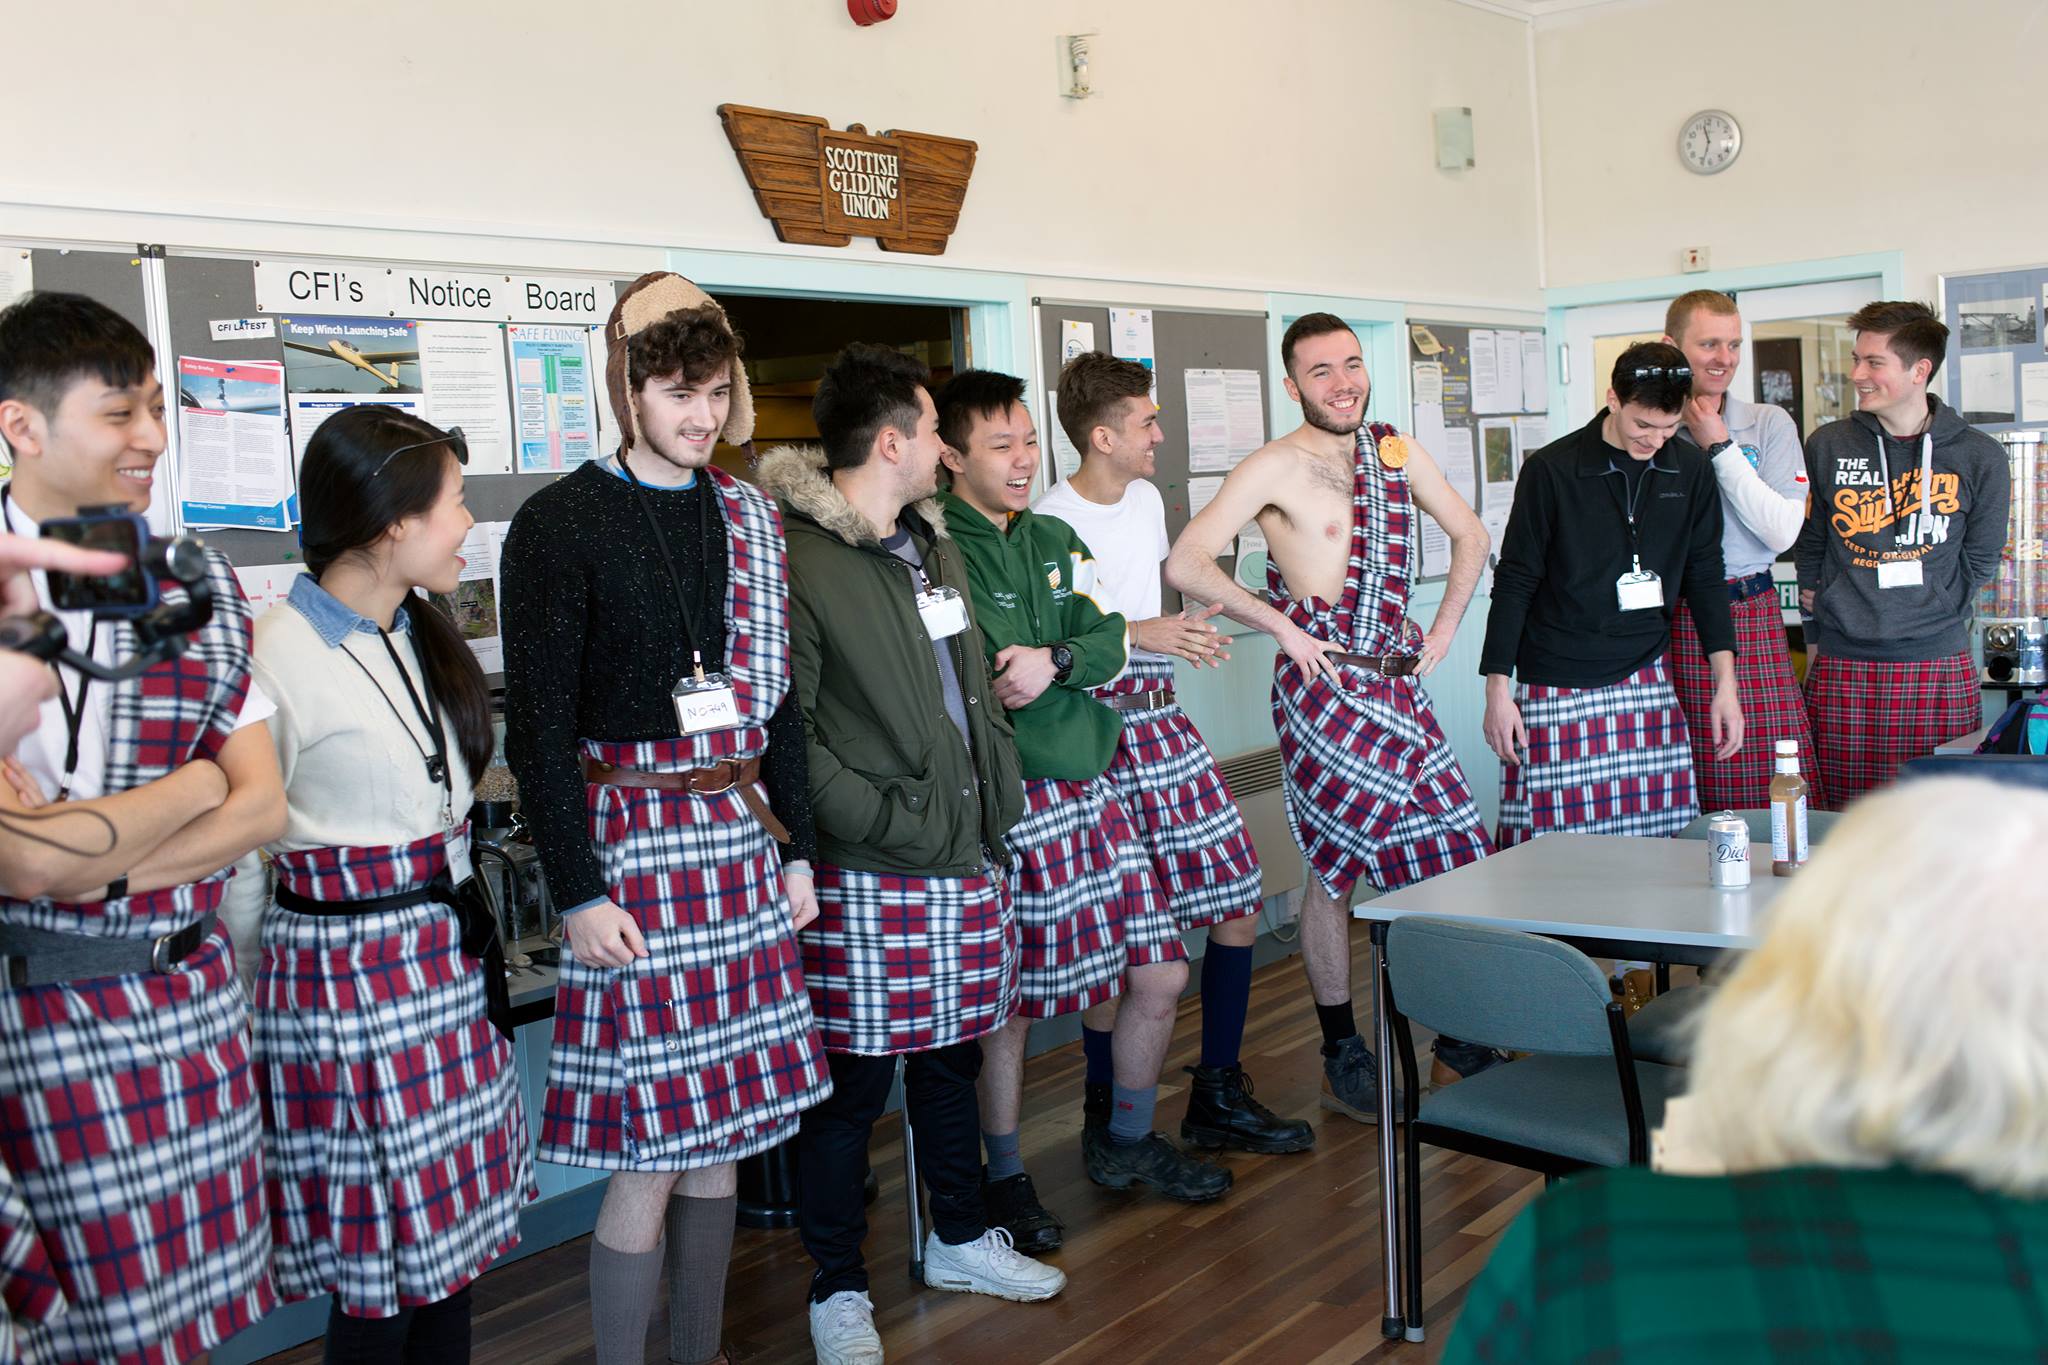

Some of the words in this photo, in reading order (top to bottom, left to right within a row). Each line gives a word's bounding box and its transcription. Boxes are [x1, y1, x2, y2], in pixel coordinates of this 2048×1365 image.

[825, 146, 898, 177] SCOTTISH
[829, 169, 898, 199] GLIDING
[841, 192, 889, 219] UNION
[289, 270, 364, 303] CFI's
[409, 277, 491, 308] Notice
[526, 283, 596, 312] Board
[217, 324, 232, 332] CFI
[234, 322, 267, 331] LATEST
[291, 323, 314, 336] Keep
[315, 325, 341, 335] Winch
[344, 325, 388, 338] Launching
[389, 327, 409, 337] Safe
[1837, 458, 1870, 471] THE
[1835, 470, 1885, 486] REAL
[1843, 538, 1867, 554] KEEP
[1868, 550, 1879, 559] IT
[1881, 543, 1934, 560] ORIGINAL
[1716, 843, 1745, 863] Diet
